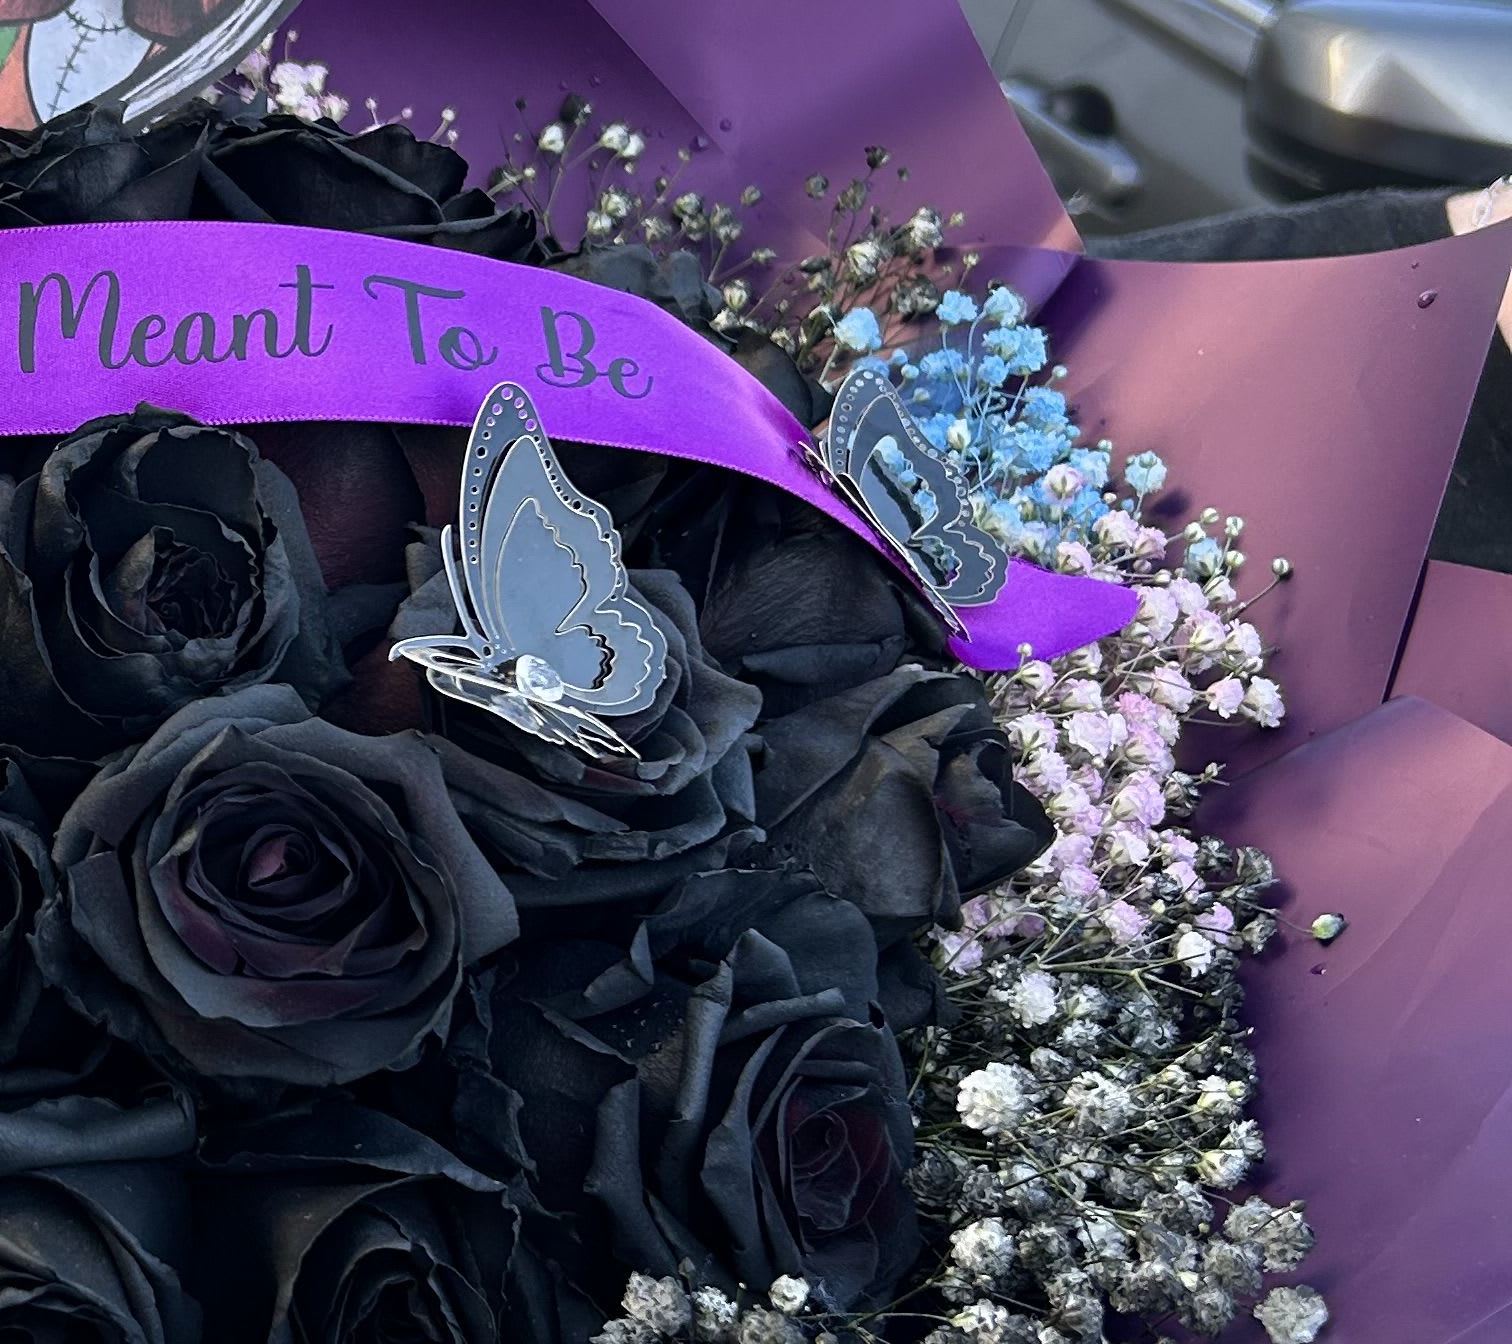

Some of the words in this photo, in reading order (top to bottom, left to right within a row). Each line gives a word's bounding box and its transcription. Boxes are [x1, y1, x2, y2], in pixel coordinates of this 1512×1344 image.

[18, 264, 334, 373] Meant
[363, 273, 498, 371] To
[535, 306, 654, 399] Be
